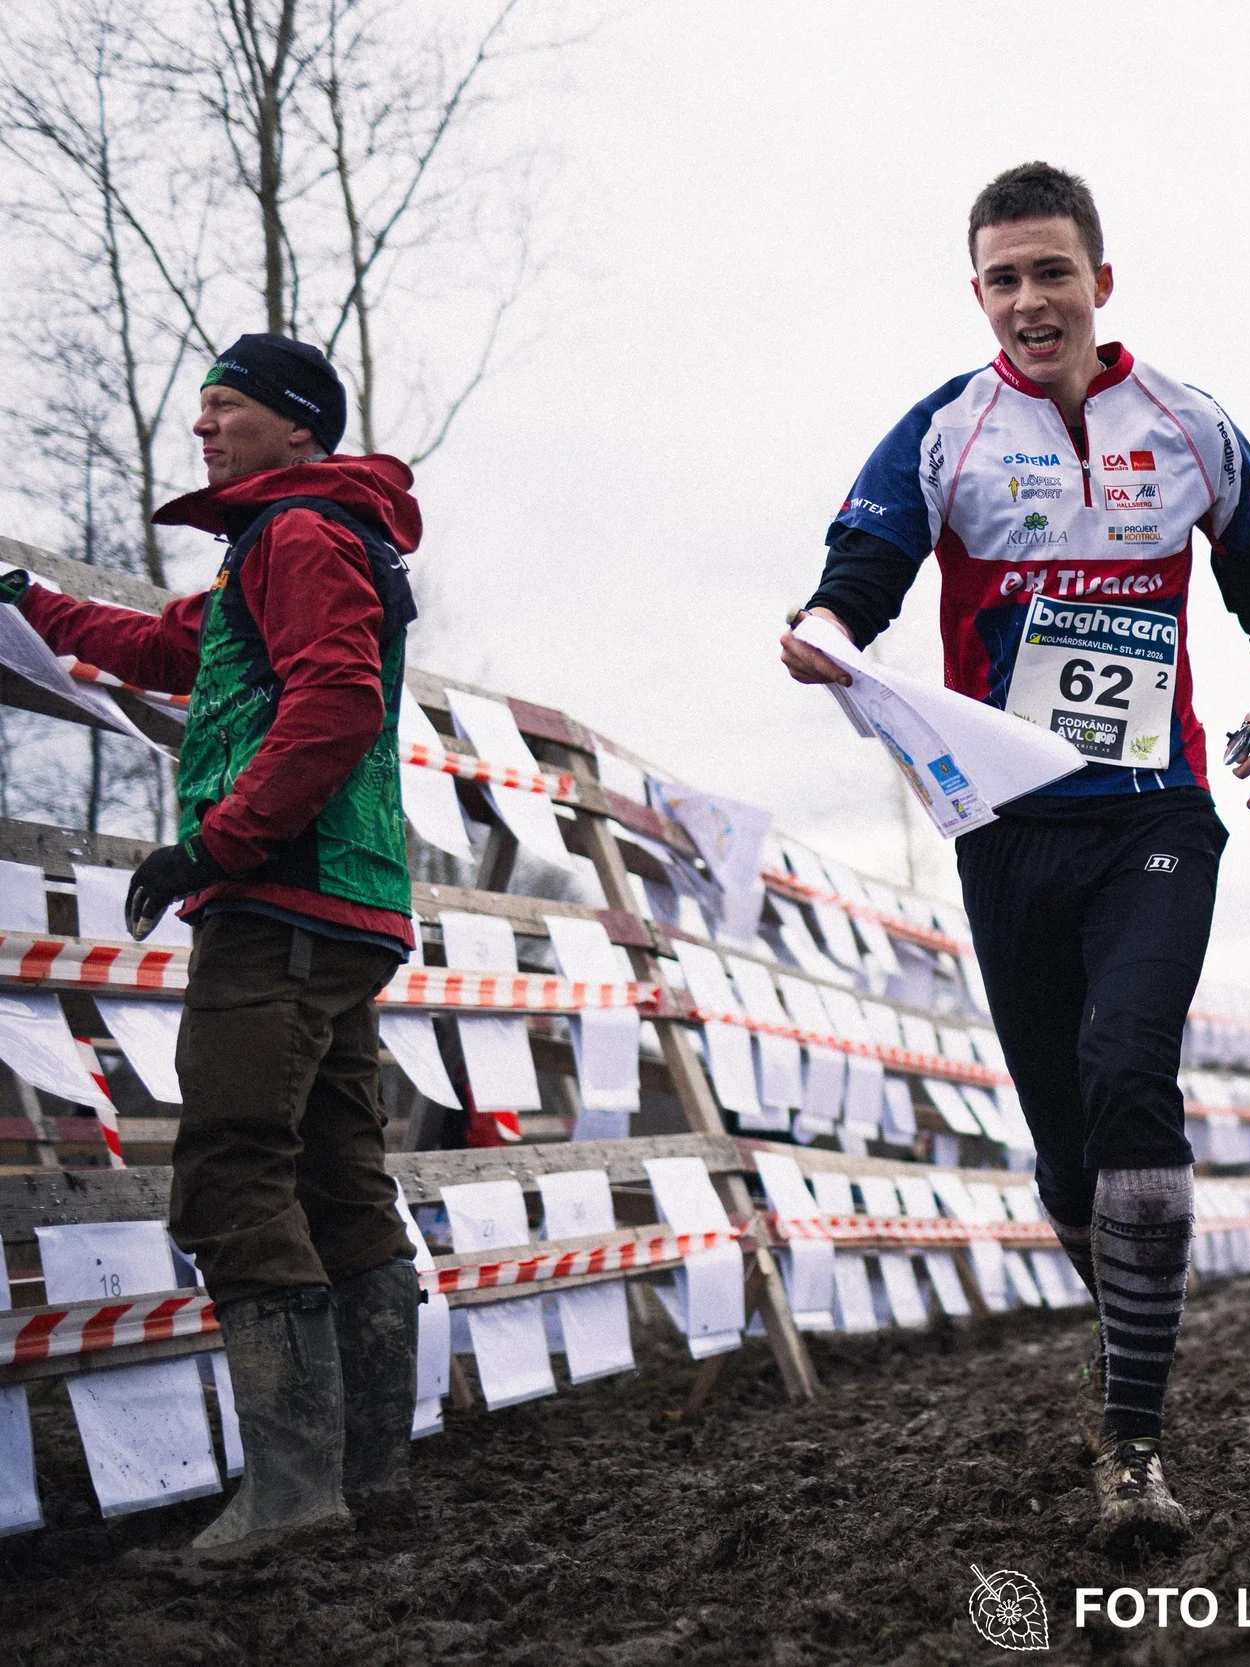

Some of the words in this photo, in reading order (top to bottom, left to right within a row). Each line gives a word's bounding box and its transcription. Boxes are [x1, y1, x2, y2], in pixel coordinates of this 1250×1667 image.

[1016, 453, 1061, 467] STENA
[1102, 454, 1128, 467] ICA
[1217, 421, 1236, 487] headlight
[1021, 489, 1063, 500] SPORT
[1107, 489, 1130, 501] ICA
[1007, 530, 1068, 545] KUMLA
[1125, 525, 1158, 533] PROJEKT
[1125, 533, 1163, 541] KONTROLL
[1057, 570, 1163, 596] Tisaren
[1032, 602, 1176, 646] bagheera
[1041, 634, 1113, 651] KOLMÅRDSKAVLEN
[1119, 646, 1134, 656] STL
[1135, 648, 1146, 657] #1
[1147, 650, 1164, 661] 2026
[1059, 658, 1134, 710] 62
[1155, 671, 1169, 690] 2
[1058, 716, 1119, 734] GODKÄNDA
[100, 1273, 121, 1297] 18
